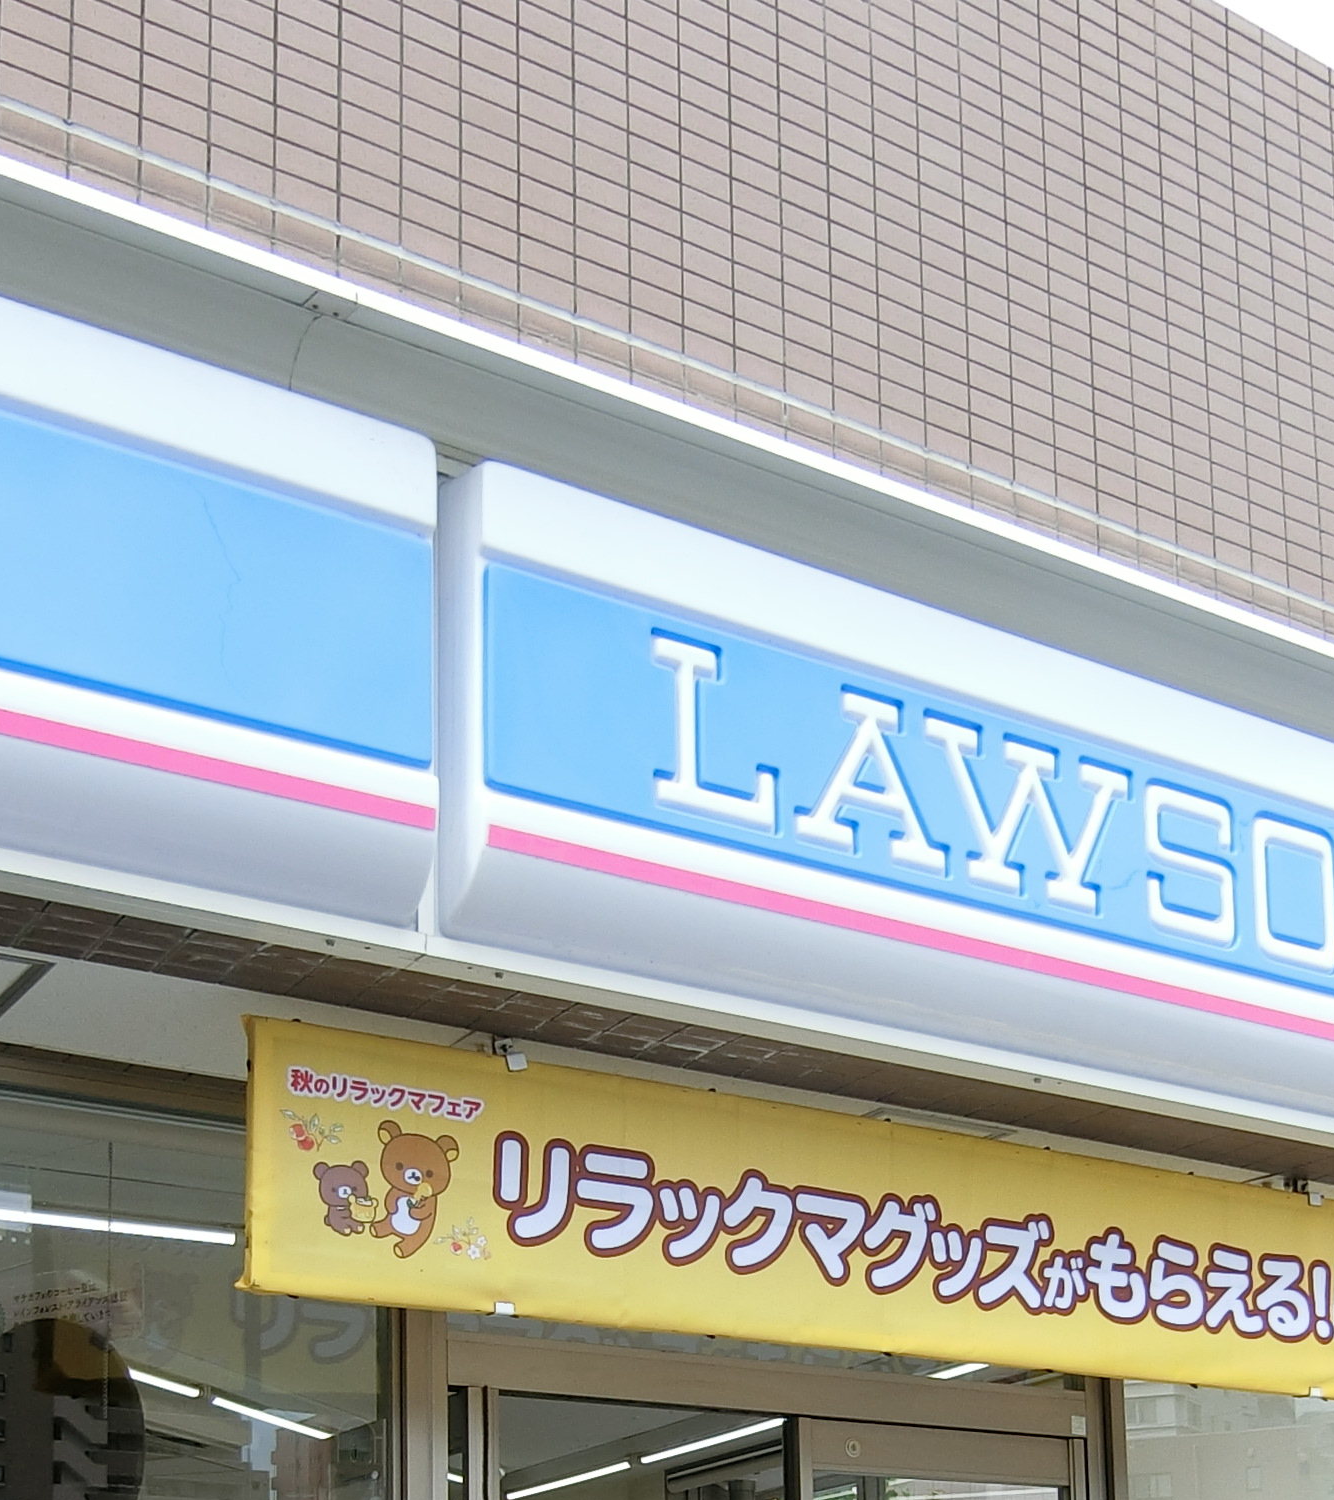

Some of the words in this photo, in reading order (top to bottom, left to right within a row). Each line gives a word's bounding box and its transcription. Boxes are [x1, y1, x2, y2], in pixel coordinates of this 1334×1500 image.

[288, 1067, 483, 1120] 秋のリラックマフェア
[493, 1130, 1334, 1344] リラックマグッズがもらえる!
